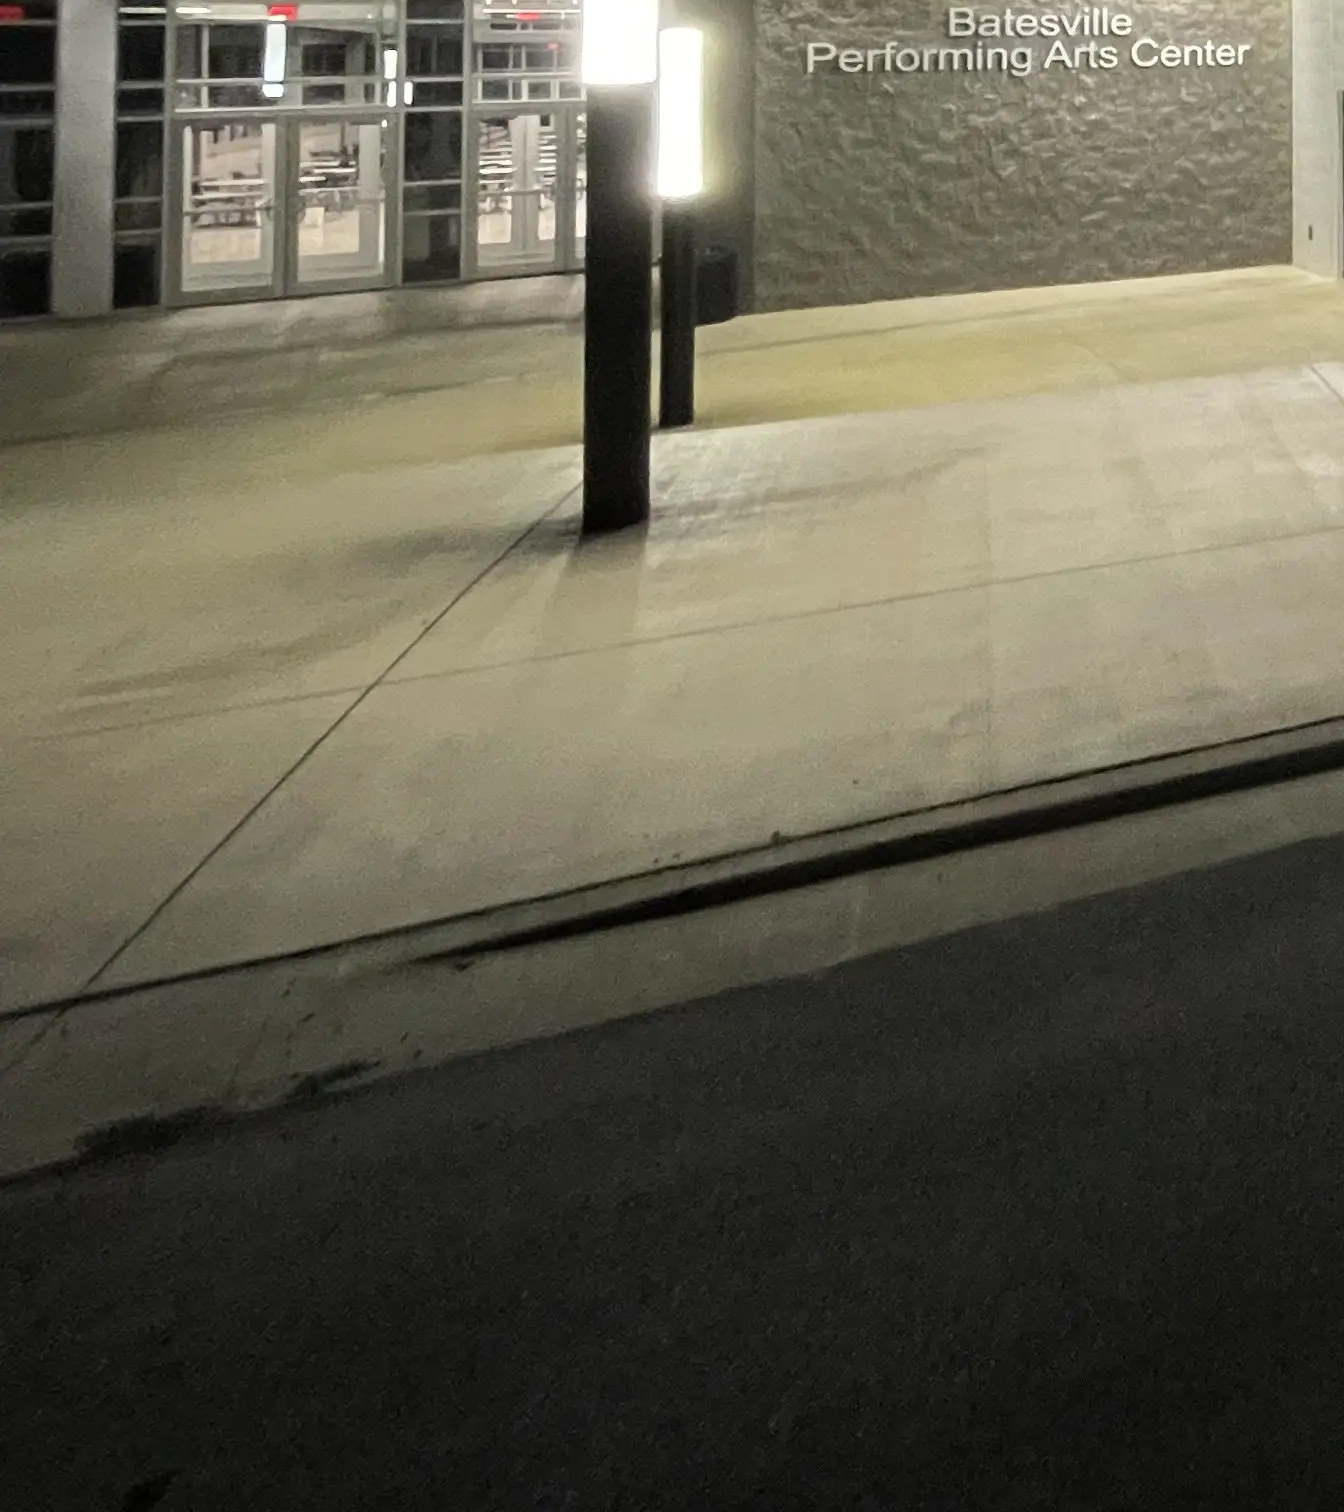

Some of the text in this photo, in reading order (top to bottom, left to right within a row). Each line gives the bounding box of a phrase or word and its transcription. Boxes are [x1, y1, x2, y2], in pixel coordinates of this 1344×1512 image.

[947, 6, 1133, 37] Batesville
[806, 37, 1252, 77] Performing Arts Center
